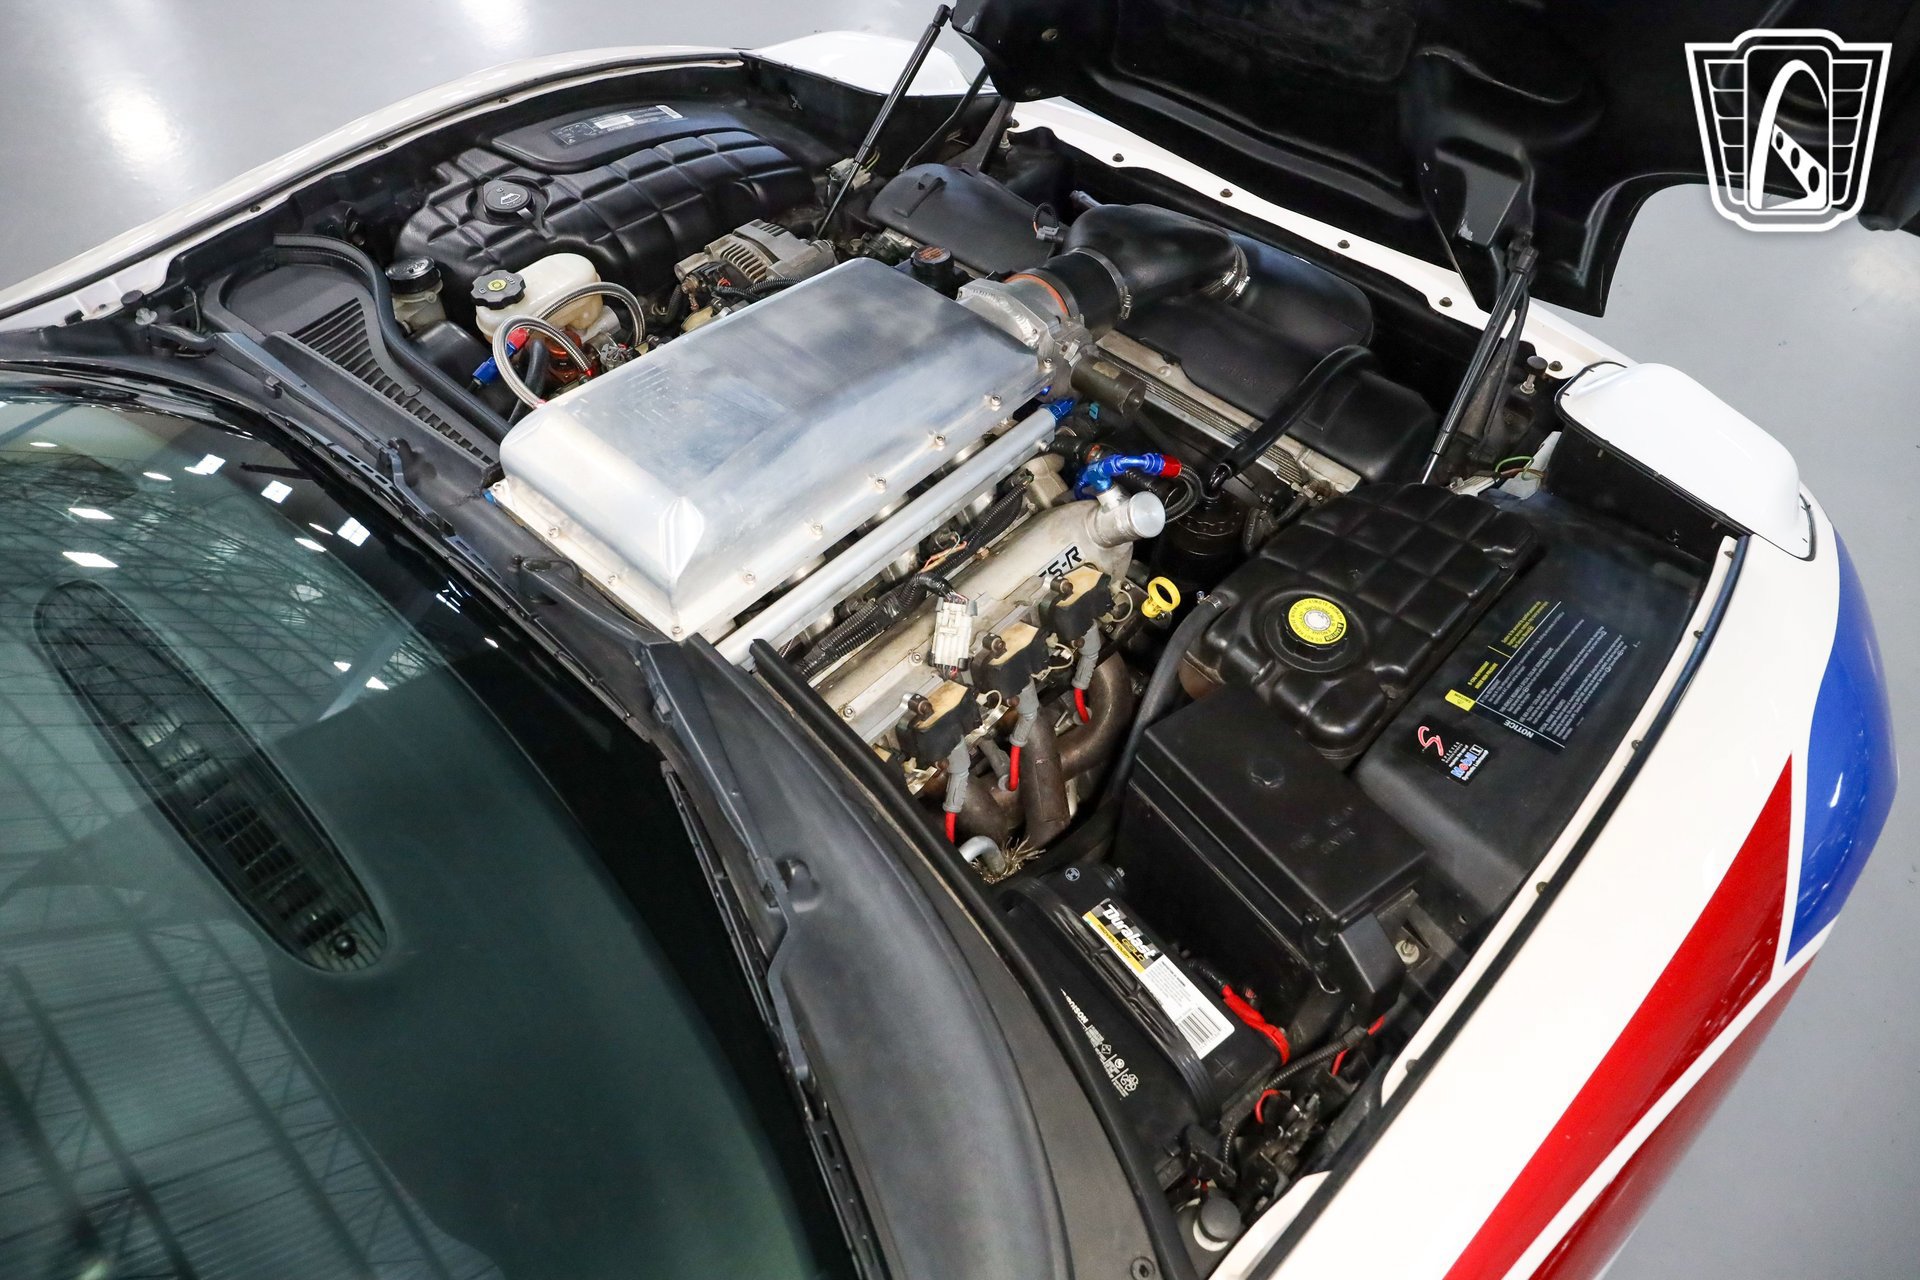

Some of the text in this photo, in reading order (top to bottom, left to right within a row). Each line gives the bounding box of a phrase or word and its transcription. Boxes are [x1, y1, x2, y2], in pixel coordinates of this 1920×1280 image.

[1503, 719, 1534, 738] NOTICE
[1450, 752, 1478, 778] Mobil
[1097, 923, 1132, 960] PROVEN TOUGH
[1102, 904, 1157, 960] Duralast
[1121, 938, 1145, 962] GOLD
